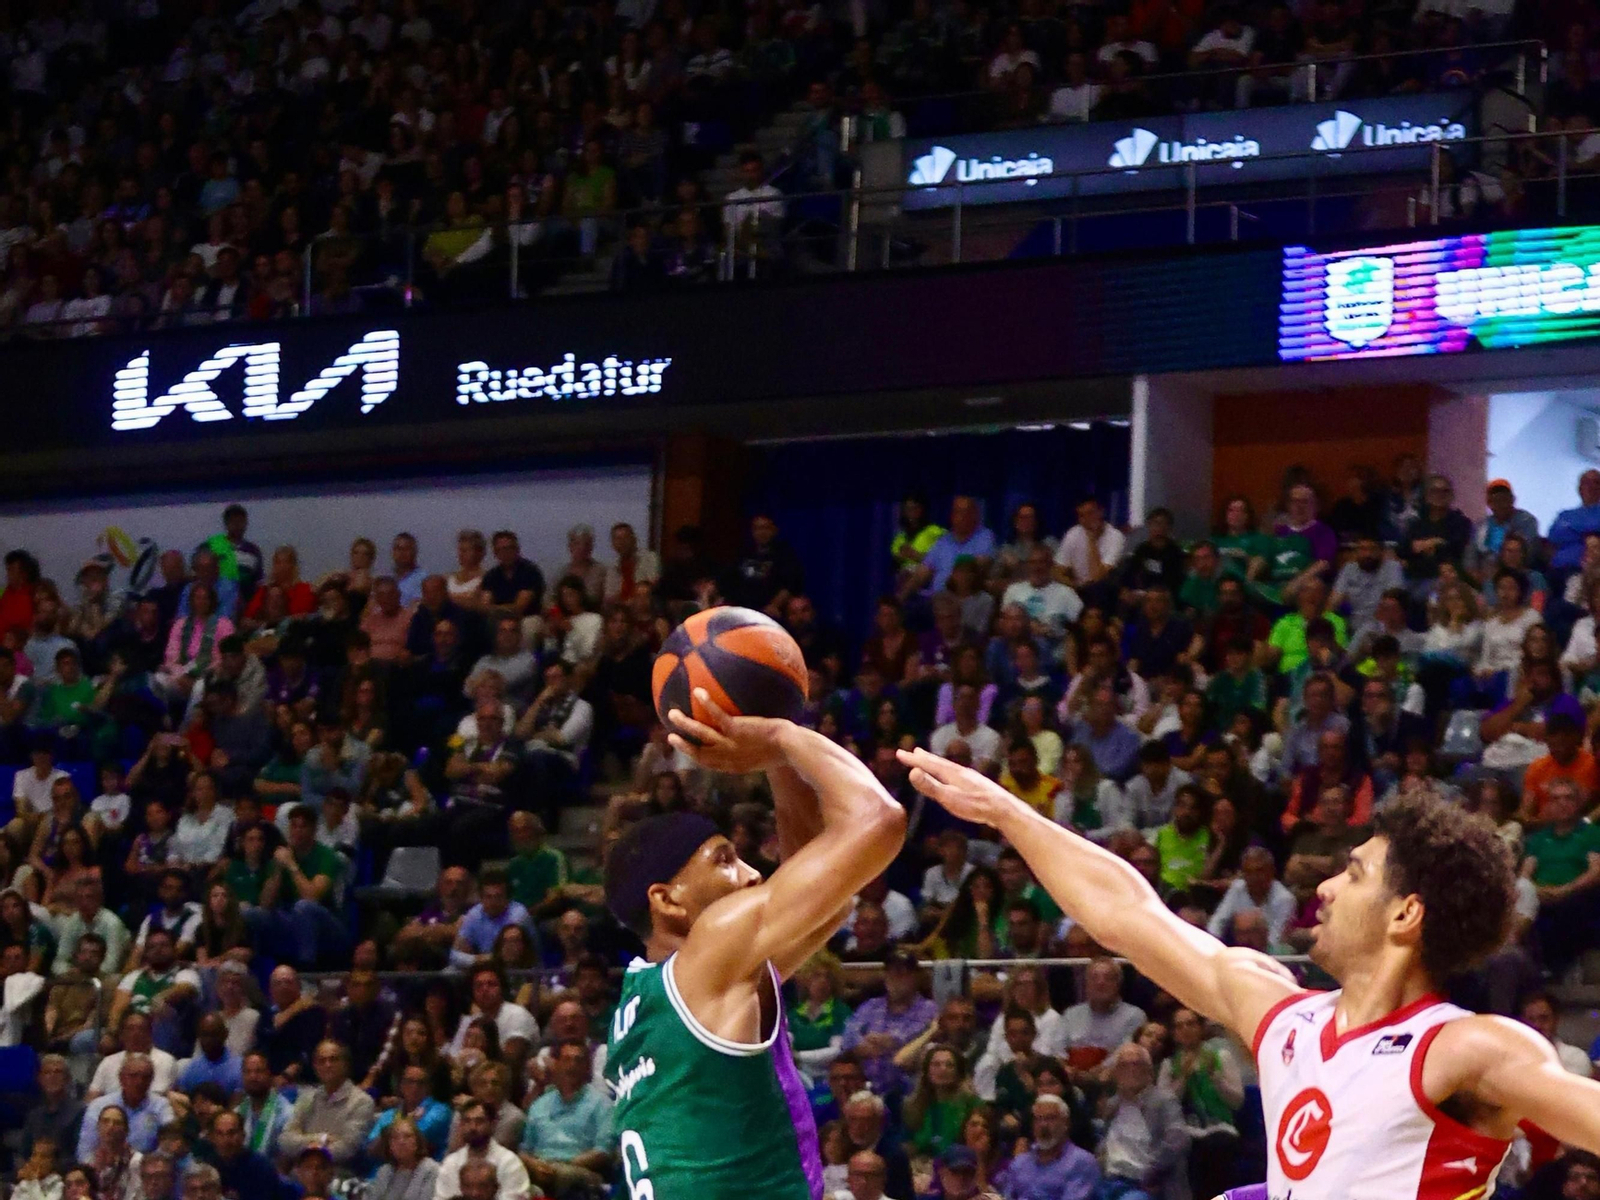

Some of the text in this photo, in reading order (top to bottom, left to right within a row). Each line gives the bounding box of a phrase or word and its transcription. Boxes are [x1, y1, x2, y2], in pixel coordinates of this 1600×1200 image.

[956, 152, 1054, 186] Unicaja
[1159, 134, 1261, 169] Unicaja
[457, 352, 672, 405] Ruedatur
